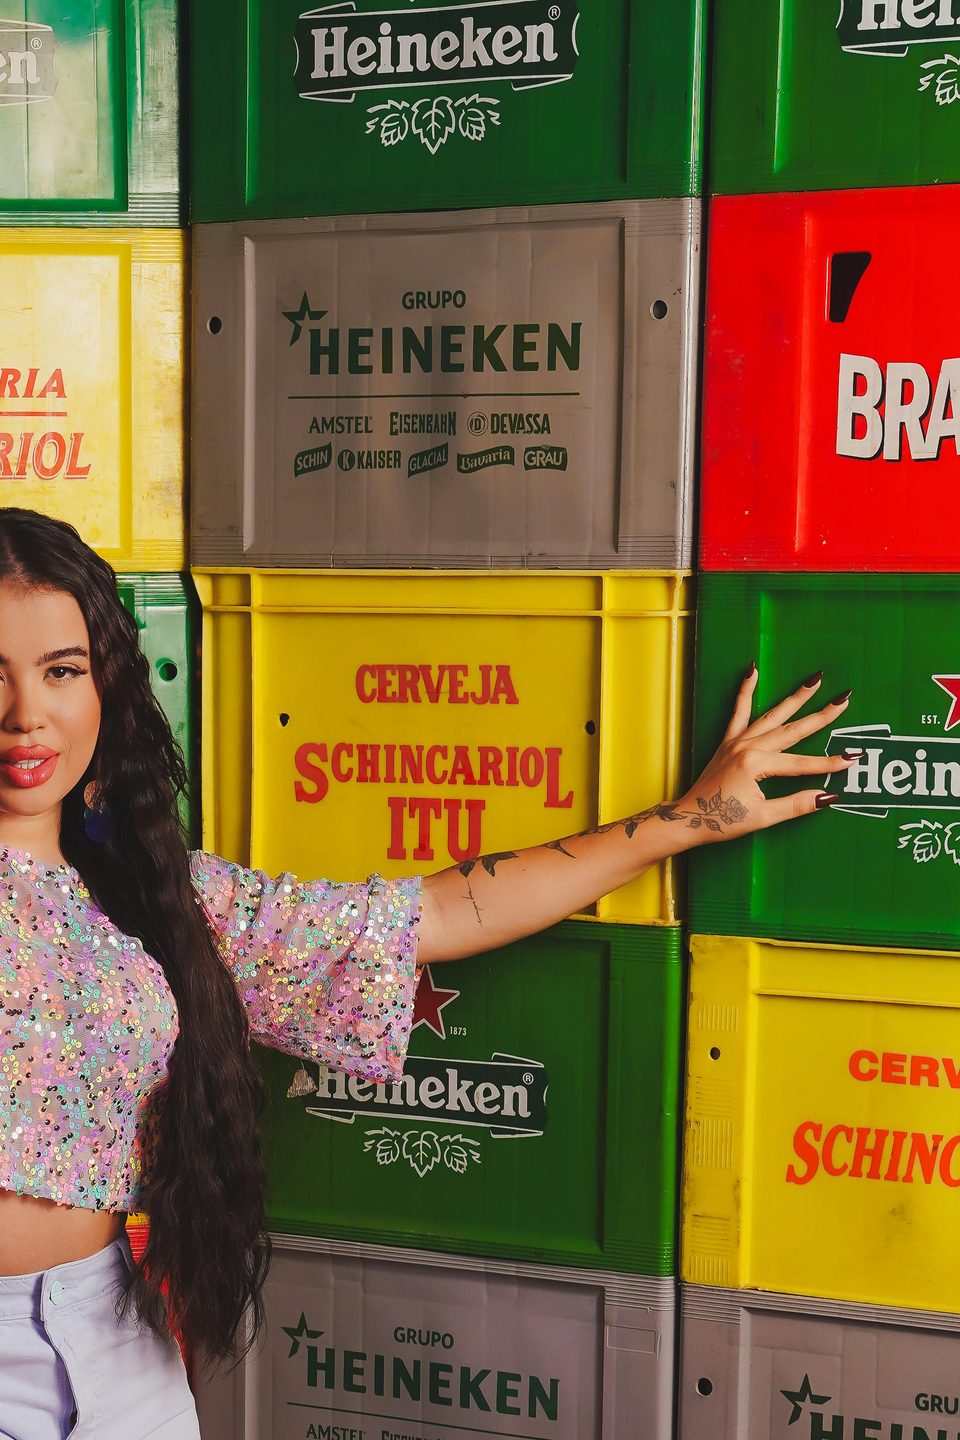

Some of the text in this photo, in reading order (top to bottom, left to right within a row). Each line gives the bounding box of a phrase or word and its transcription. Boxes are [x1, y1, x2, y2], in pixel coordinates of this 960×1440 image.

[311, 17, 558, 79] Heineken
[402, 290, 466, 310] GRUPO
[309, 322, 582, 375] HEINEKEN
[309, 416, 373, 434] AMSTEL
[390, 411, 456, 436] EISENBAHN
[491, 413, 550, 435] DEVASSA
[836, 353, 960, 462] BRA
[296, 449, 328, 471] SCHIN
[357, 450, 401, 469] KAISER
[409, 449, 447, 472] GLACIAL
[460, 447, 511, 471] Bavaria
[524, 450, 562, 466] GRAU
[355, 664, 519, 705] CERVEJA
[921, 714, 941, 725] EST.
[294, 742, 574, 808] SCHINCARIOL
[387, 797, 486, 862] ITU
[449, 1026, 467, 1037] 1873
[393, 1326, 454, 1350] GRUPO
[306, 1345, 560, 1421] HEINEKEN
